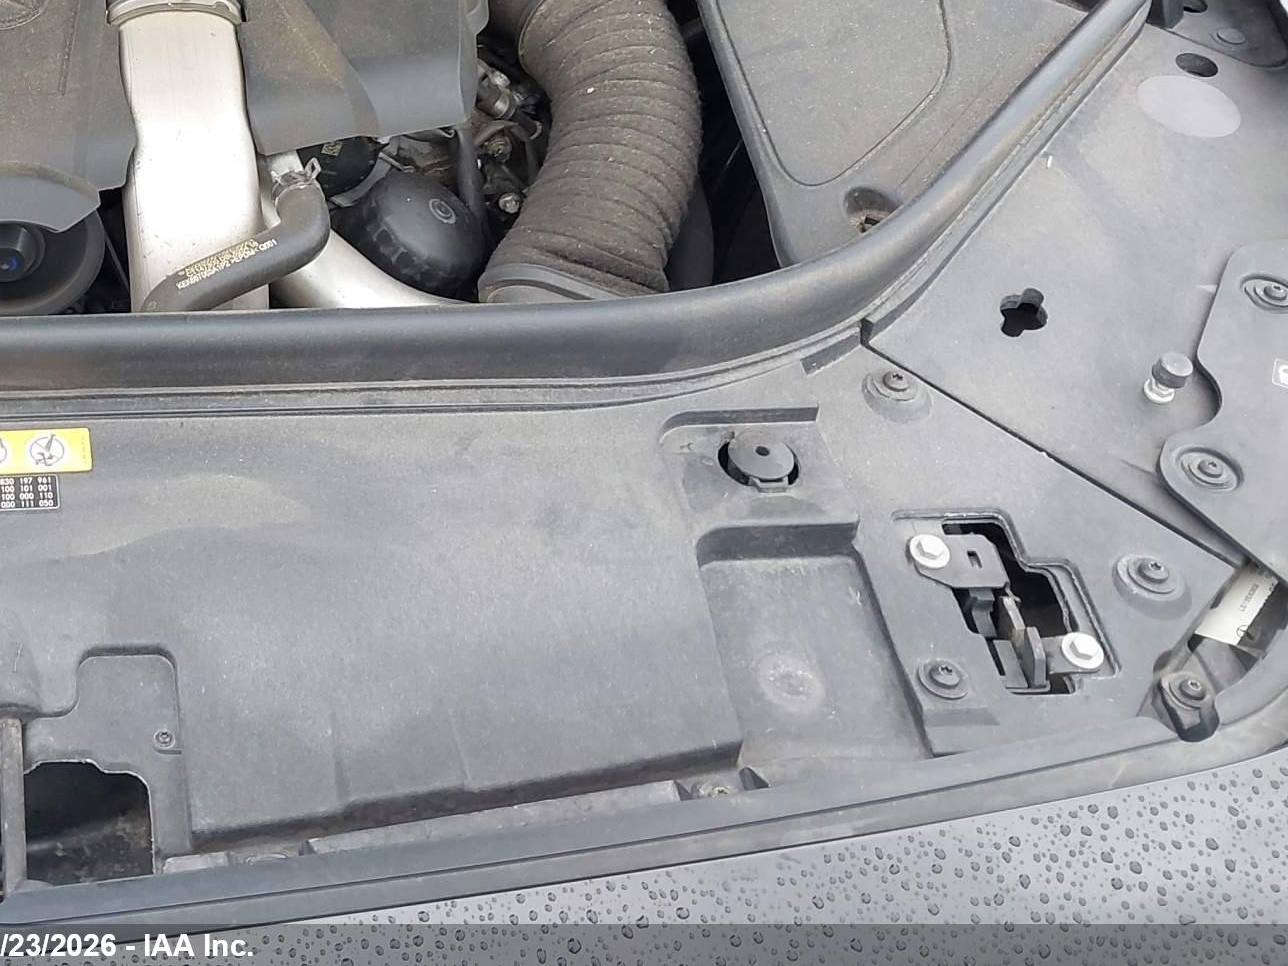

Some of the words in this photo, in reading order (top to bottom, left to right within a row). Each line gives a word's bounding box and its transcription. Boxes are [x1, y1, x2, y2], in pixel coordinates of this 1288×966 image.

[20, 476, 33, 484] 197
[37, 475, 51, 484] 961
[1, 485, 15, 493] 100
[20, 484, 33, 492] 101
[37, 484, 52, 492] 001
[2, 493, 16, 501] 100
[19, 492, 35, 500] 000
[39, 491, 54, 499] 110
[21, 500, 34, 508] 111
